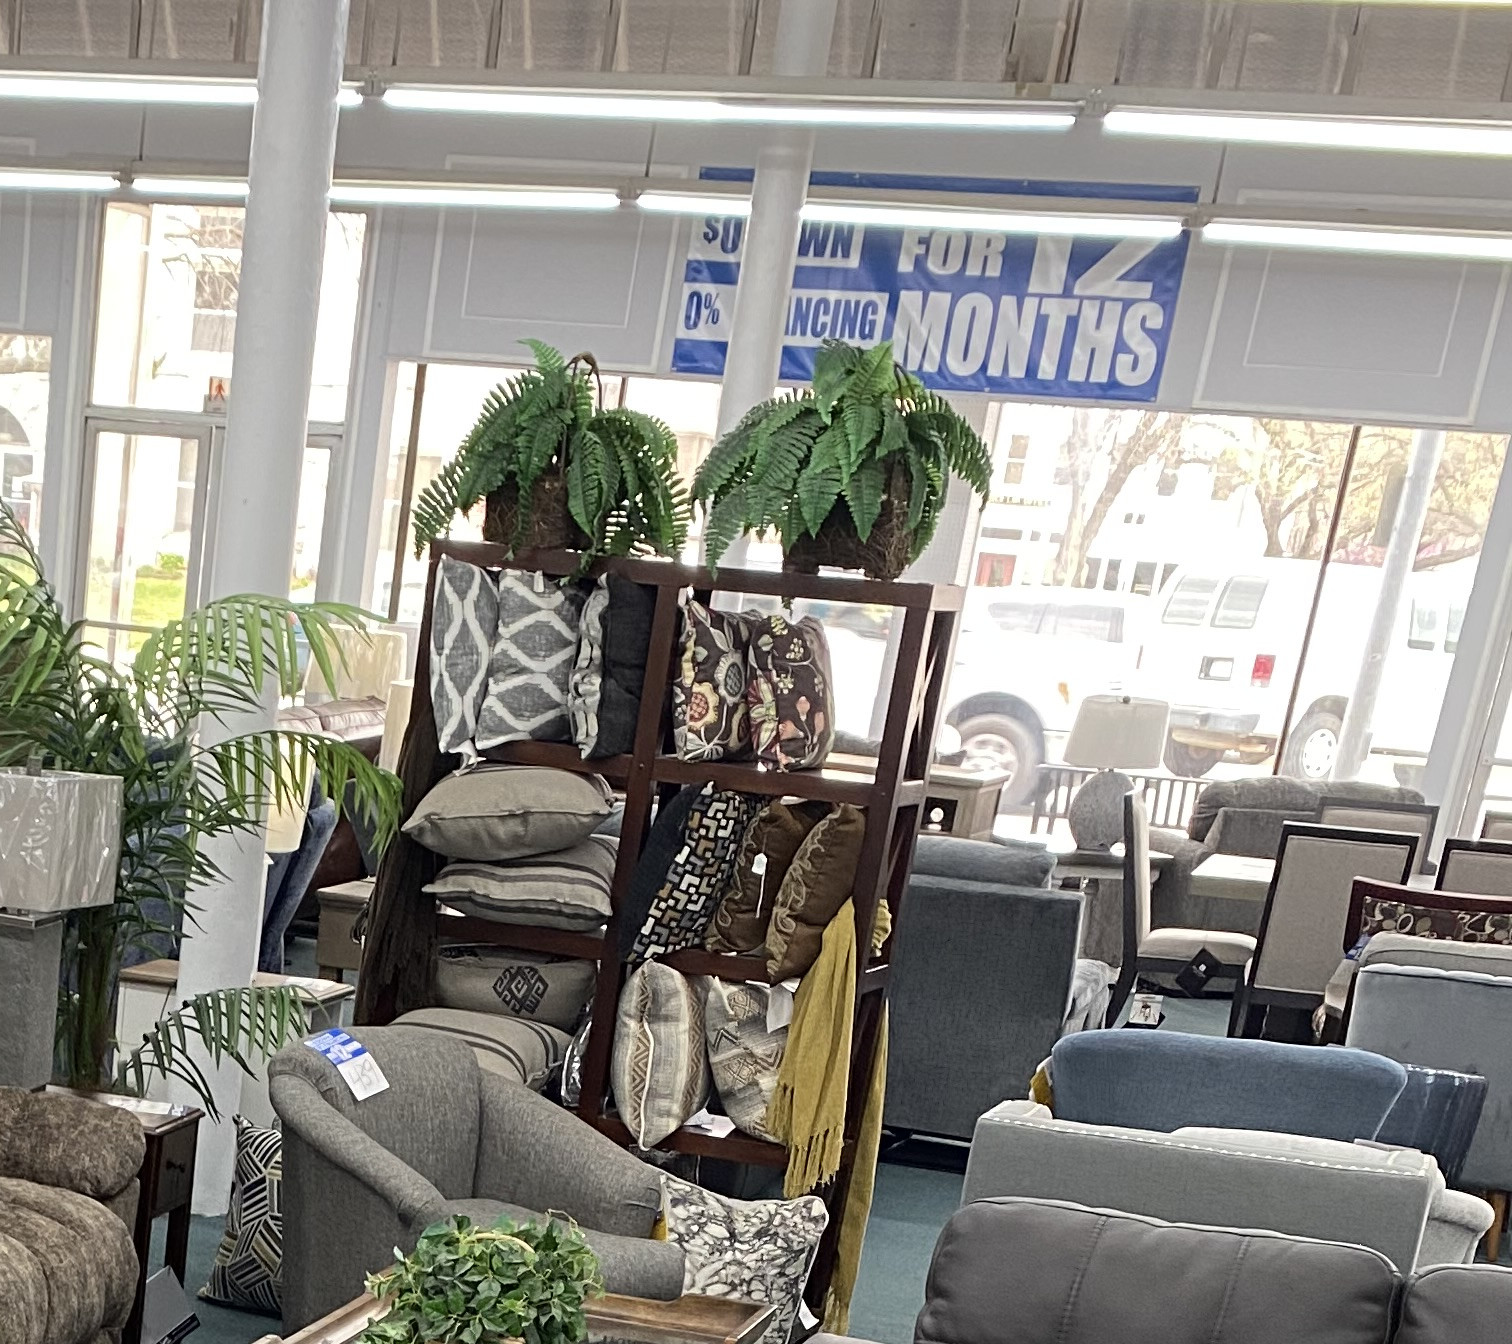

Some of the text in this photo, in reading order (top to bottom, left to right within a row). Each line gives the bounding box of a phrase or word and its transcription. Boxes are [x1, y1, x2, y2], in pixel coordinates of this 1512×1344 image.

[702, 215, 744, 254] $0
[897, 228, 1007, 278] FOR
[684, 291, 879, 341] 0% NCING
[892, 290, 1165, 388] MONTHS
